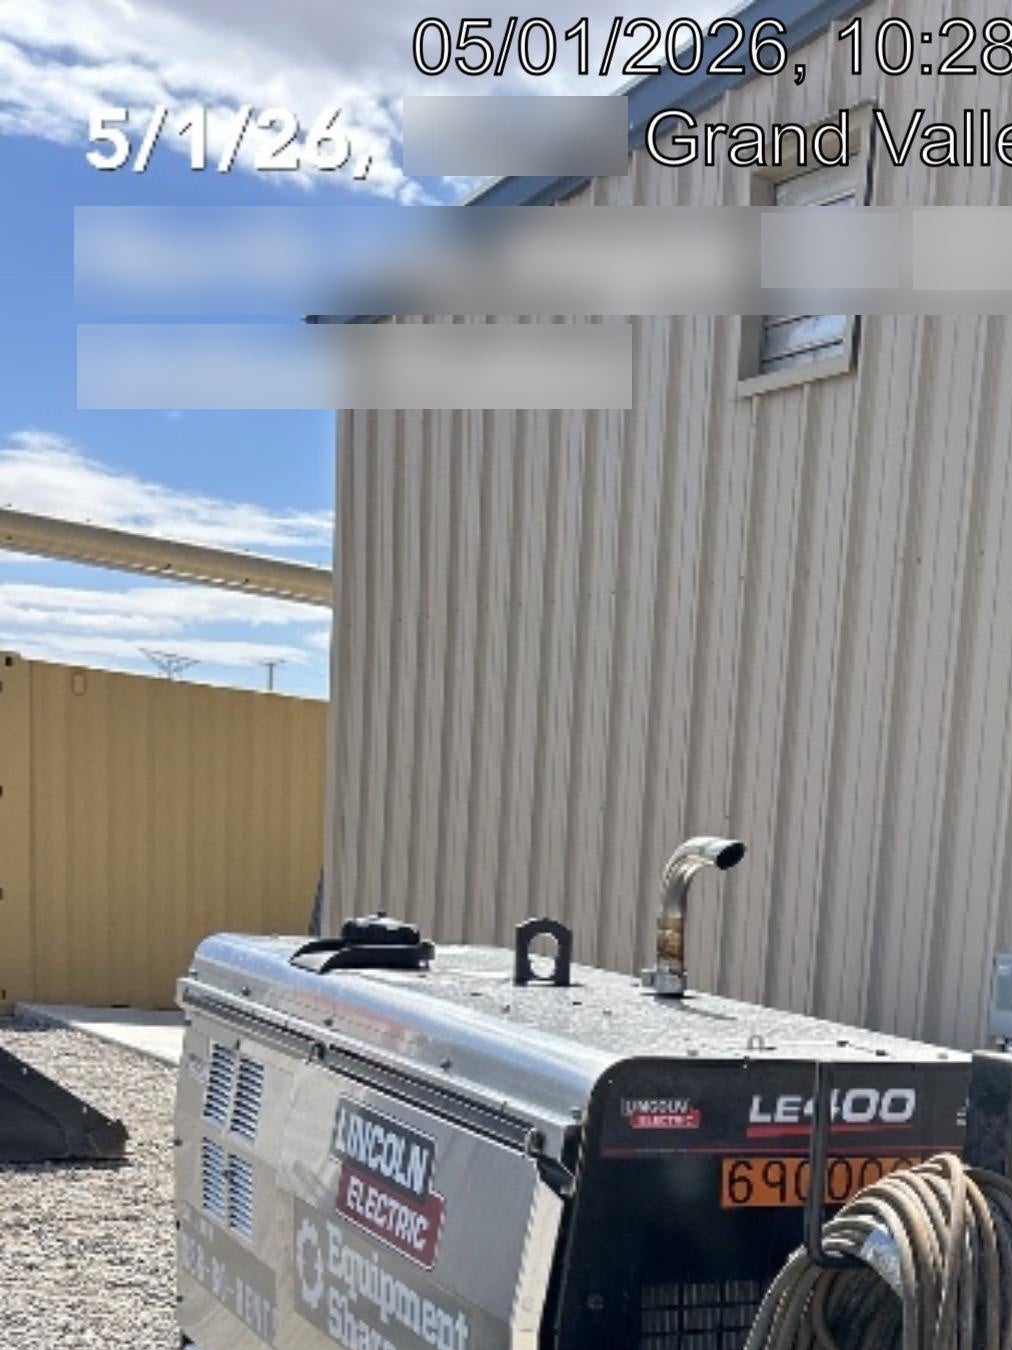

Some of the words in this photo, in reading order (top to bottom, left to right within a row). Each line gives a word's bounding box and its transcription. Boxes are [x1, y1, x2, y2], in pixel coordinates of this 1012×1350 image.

[622, 1098, 690, 1116] LINCOLN
[335, 1107, 429, 1195] LINCOLN
[728, 1159, 916, 1204] 69000
[347, 1175, 428, 1251] ELECTRIC
